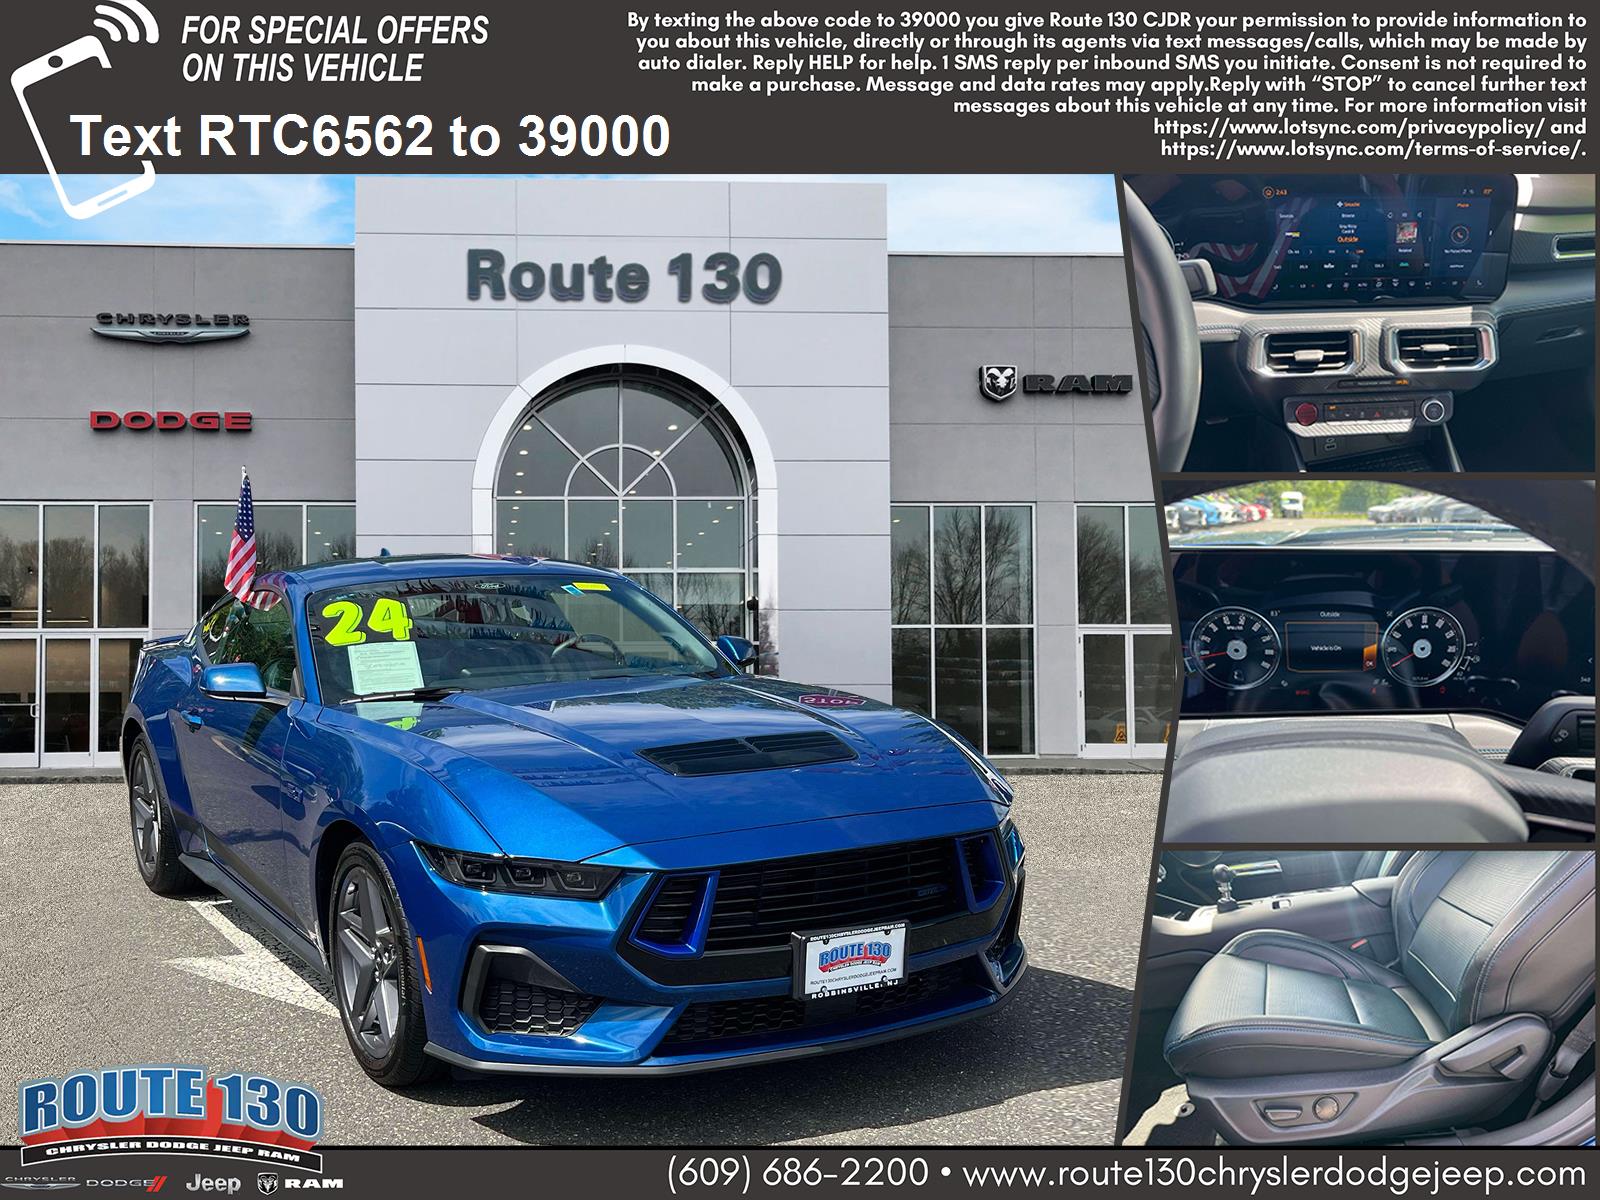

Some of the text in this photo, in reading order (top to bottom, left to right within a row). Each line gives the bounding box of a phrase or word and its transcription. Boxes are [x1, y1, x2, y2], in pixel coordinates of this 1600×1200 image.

[467, 249, 783, 304] Route 130
[96, 313, 250, 326] CHRYSLER
[1023, 374, 1133, 394] RAM
[90, 411, 253, 430] DODGE
[322, 597, 413, 646] 24
[819, 942, 864, 966] ROUTE
[866, 942, 892, 959] 130
